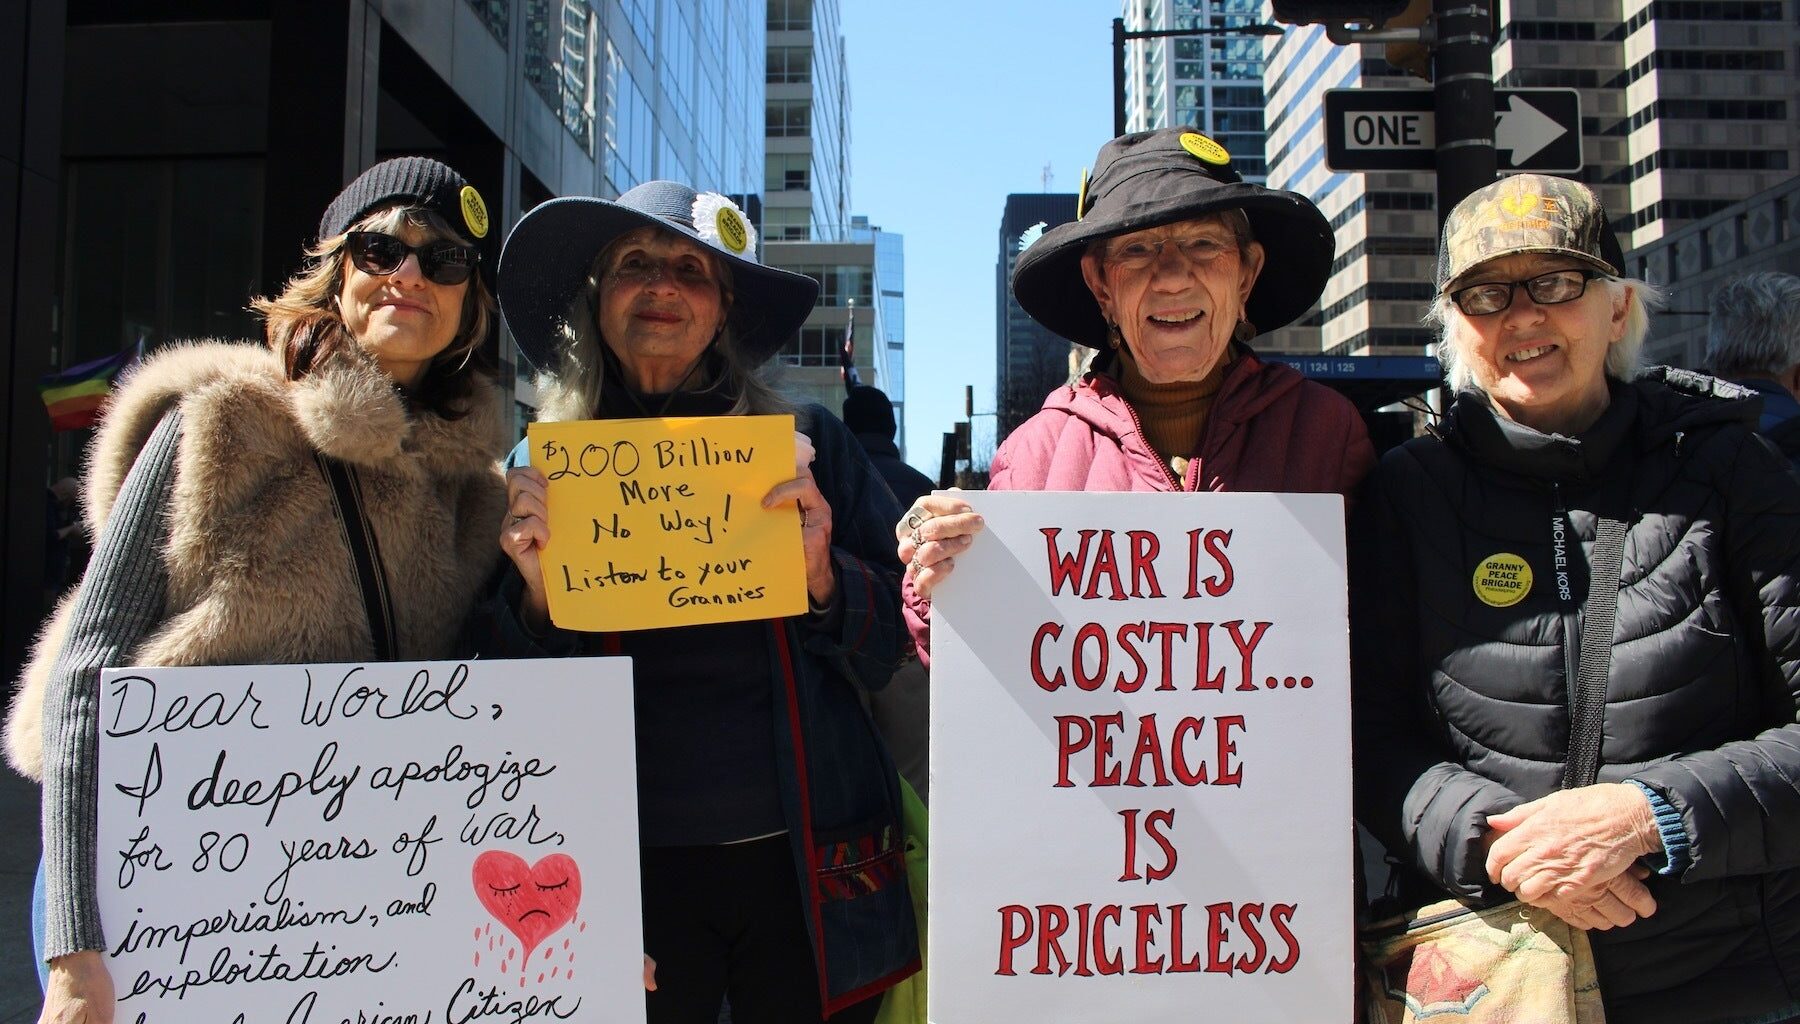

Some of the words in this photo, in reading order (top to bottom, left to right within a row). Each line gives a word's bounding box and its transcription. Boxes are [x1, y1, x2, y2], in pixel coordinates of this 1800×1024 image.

[1353, 115, 1421, 146] ONE
[1311, 362, 1329, 373] 124
[1337, 362, 1356, 373] 125
[542, 440, 641, 481] $200
[653, 437, 754, 469] Billion
[620, 480, 695, 506] More
[592, 513, 631, 544] No
[660, 494, 731, 544] Way!
[1552, 517, 1567, 570] MICHAEL
[657, 556, 686, 581] to
[699, 558, 752, 585] your
[1039, 528, 1167, 601] WAR
[1182, 528, 1235, 600] IS
[1481, 578, 1523, 590] BRIGADE
[1485, 562, 1524, 572] GRANNY
[1488, 570, 1519, 580] PEACE
[1556, 571, 1572, 601] KORS
[668, 586, 766, 608] Grannies
[1030, 620, 1314, 694] COSTLY...
[106, 674, 269, 738] Dear
[300, 663, 503, 727] World,
[1052, 711, 1247, 788] PEACE
[115, 742, 163, 818] I
[187, 741, 360, 827] deeply
[369, 744, 557, 809] apologize
[118, 825, 173, 889] for
[192, 832, 249, 873] 80
[264, 838, 378, 905] years
[392, 815, 443, 877] of
[459, 804, 566, 847] war,
[1117, 808, 1178, 885] IS
[110, 895, 380, 965] imperialism,
[386, 882, 438, 917] and
[993, 902, 1301, 978] PRICELESS
